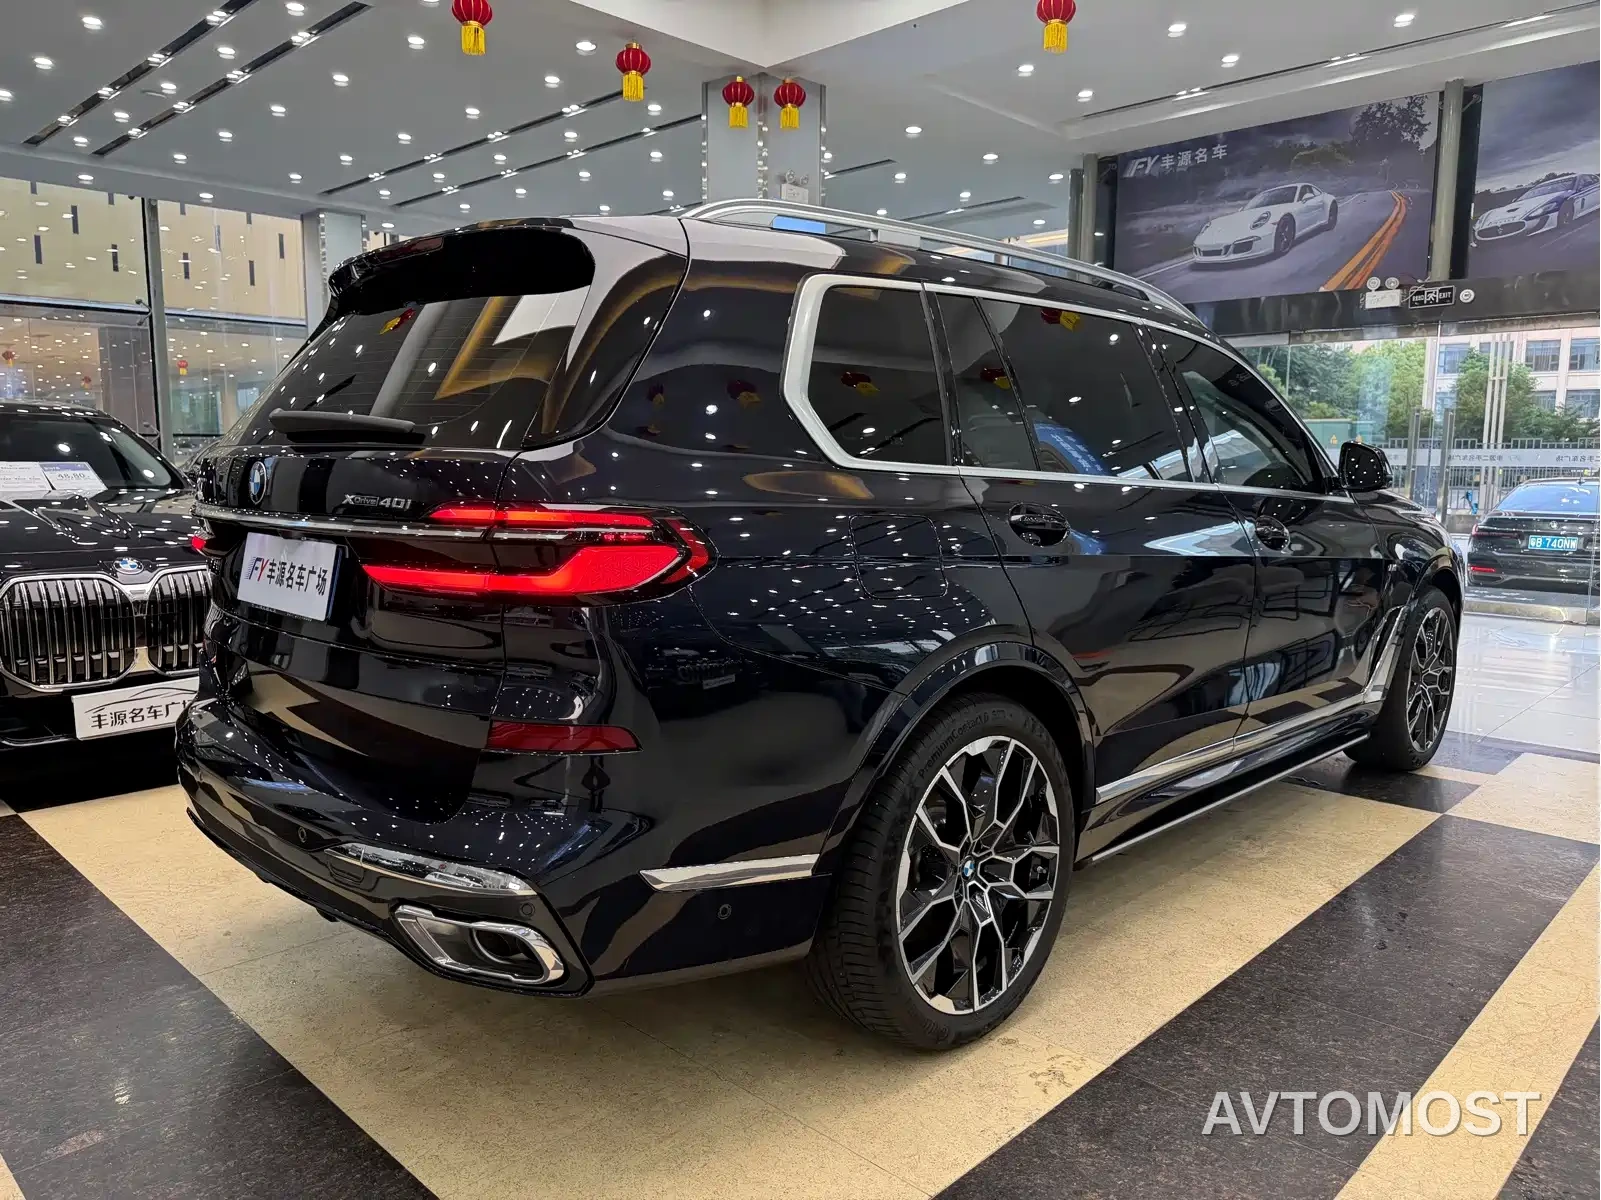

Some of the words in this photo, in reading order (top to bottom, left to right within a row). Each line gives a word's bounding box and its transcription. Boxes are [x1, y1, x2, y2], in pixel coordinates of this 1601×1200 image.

[1160, 144, 1228, 169] 丰源名车
[266, 558, 328, 596] 丰源名车广场
[91, 700, 187, 729] 丰源名车广
